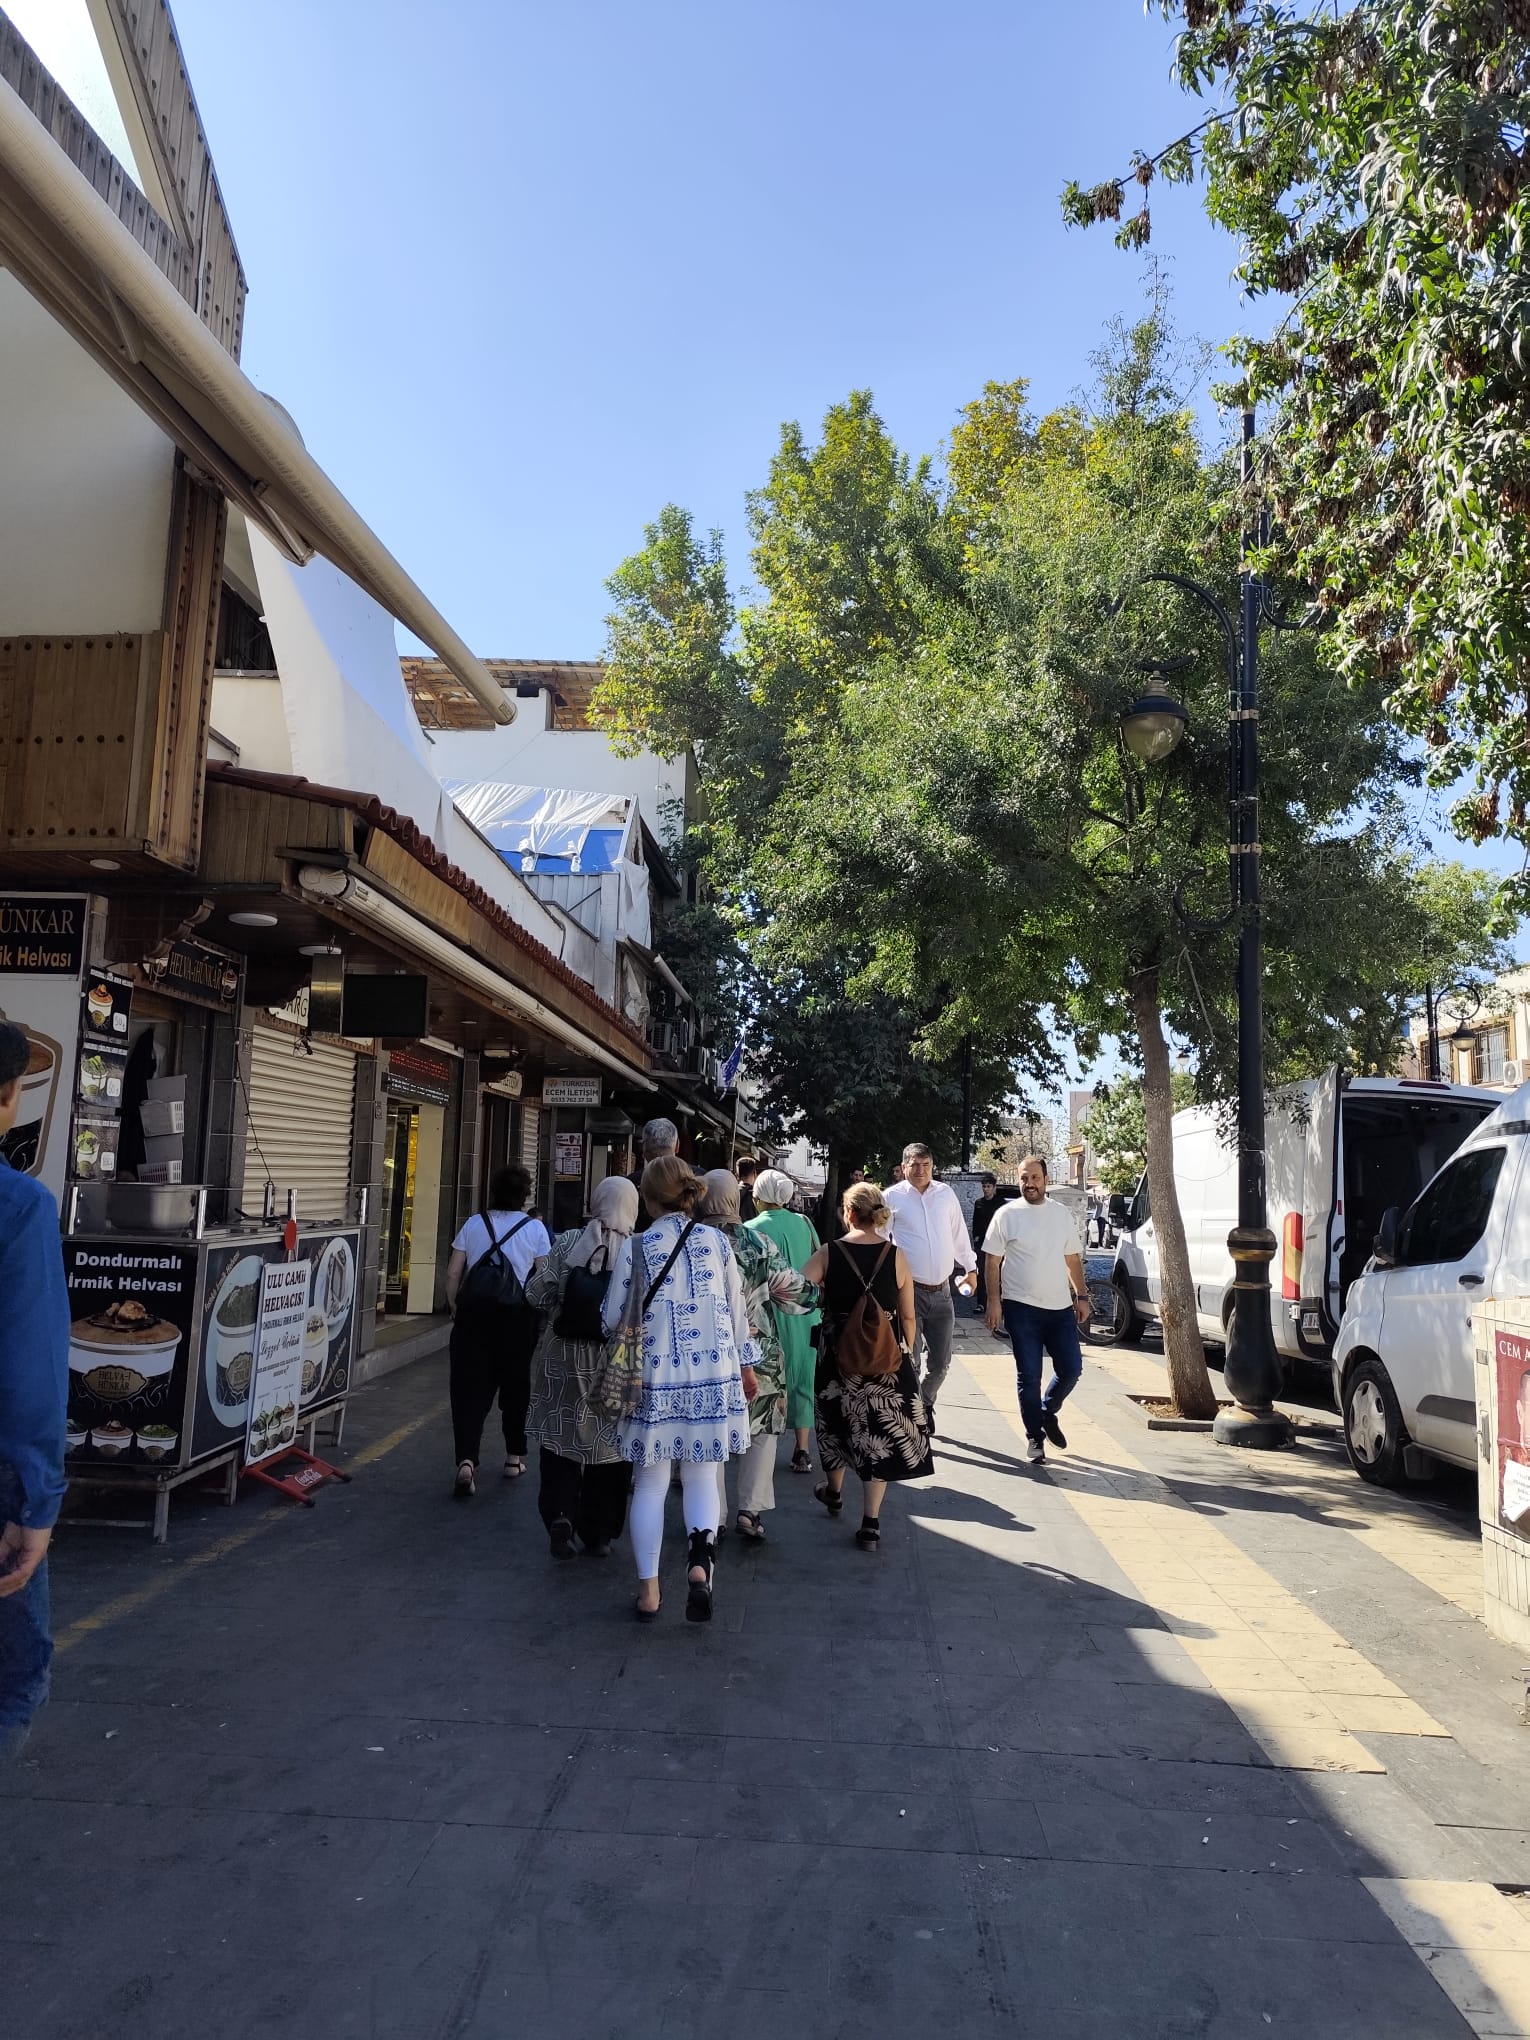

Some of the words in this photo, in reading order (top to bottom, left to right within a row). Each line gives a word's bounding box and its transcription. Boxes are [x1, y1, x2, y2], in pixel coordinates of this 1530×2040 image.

[17, 946, 71, 967] Helvası
[545, 1088, 566, 1096] ECEM
[567, 1087, 599, 1097] İLETİŞİM
[75, 1251, 182, 1269] Dondurmalı
[68, 1272, 113, 1290] İrmik
[118, 1276, 182, 1292] Helvası
[267, 1273, 284, 1290] ULU
[1499, 1340, 1521, 1360] CEM
